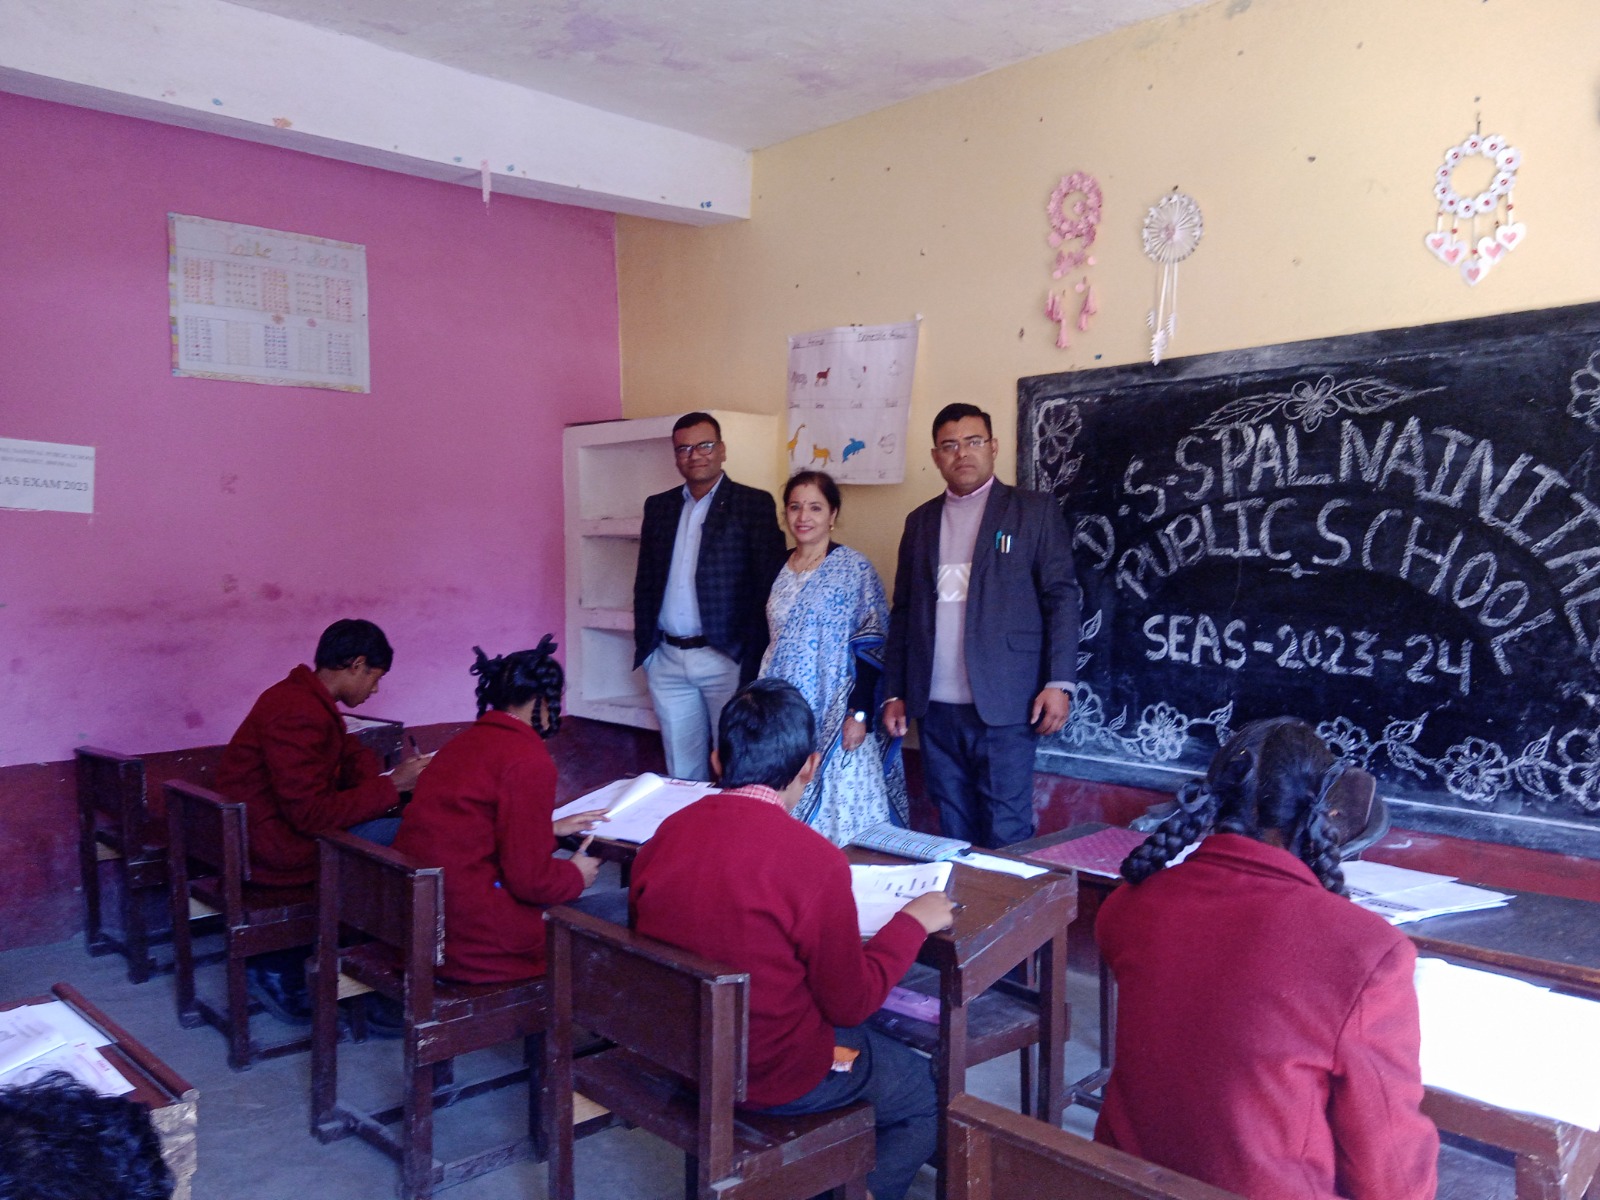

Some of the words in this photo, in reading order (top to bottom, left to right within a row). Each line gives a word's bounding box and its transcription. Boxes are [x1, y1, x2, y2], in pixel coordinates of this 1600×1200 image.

[23, 477, 61, 490] EXAM
[63, 481, 89, 492] 2023
[1115, 498, 1298, 600] PUBLIC
[1311, 498, 1556, 676] SCHOOL
